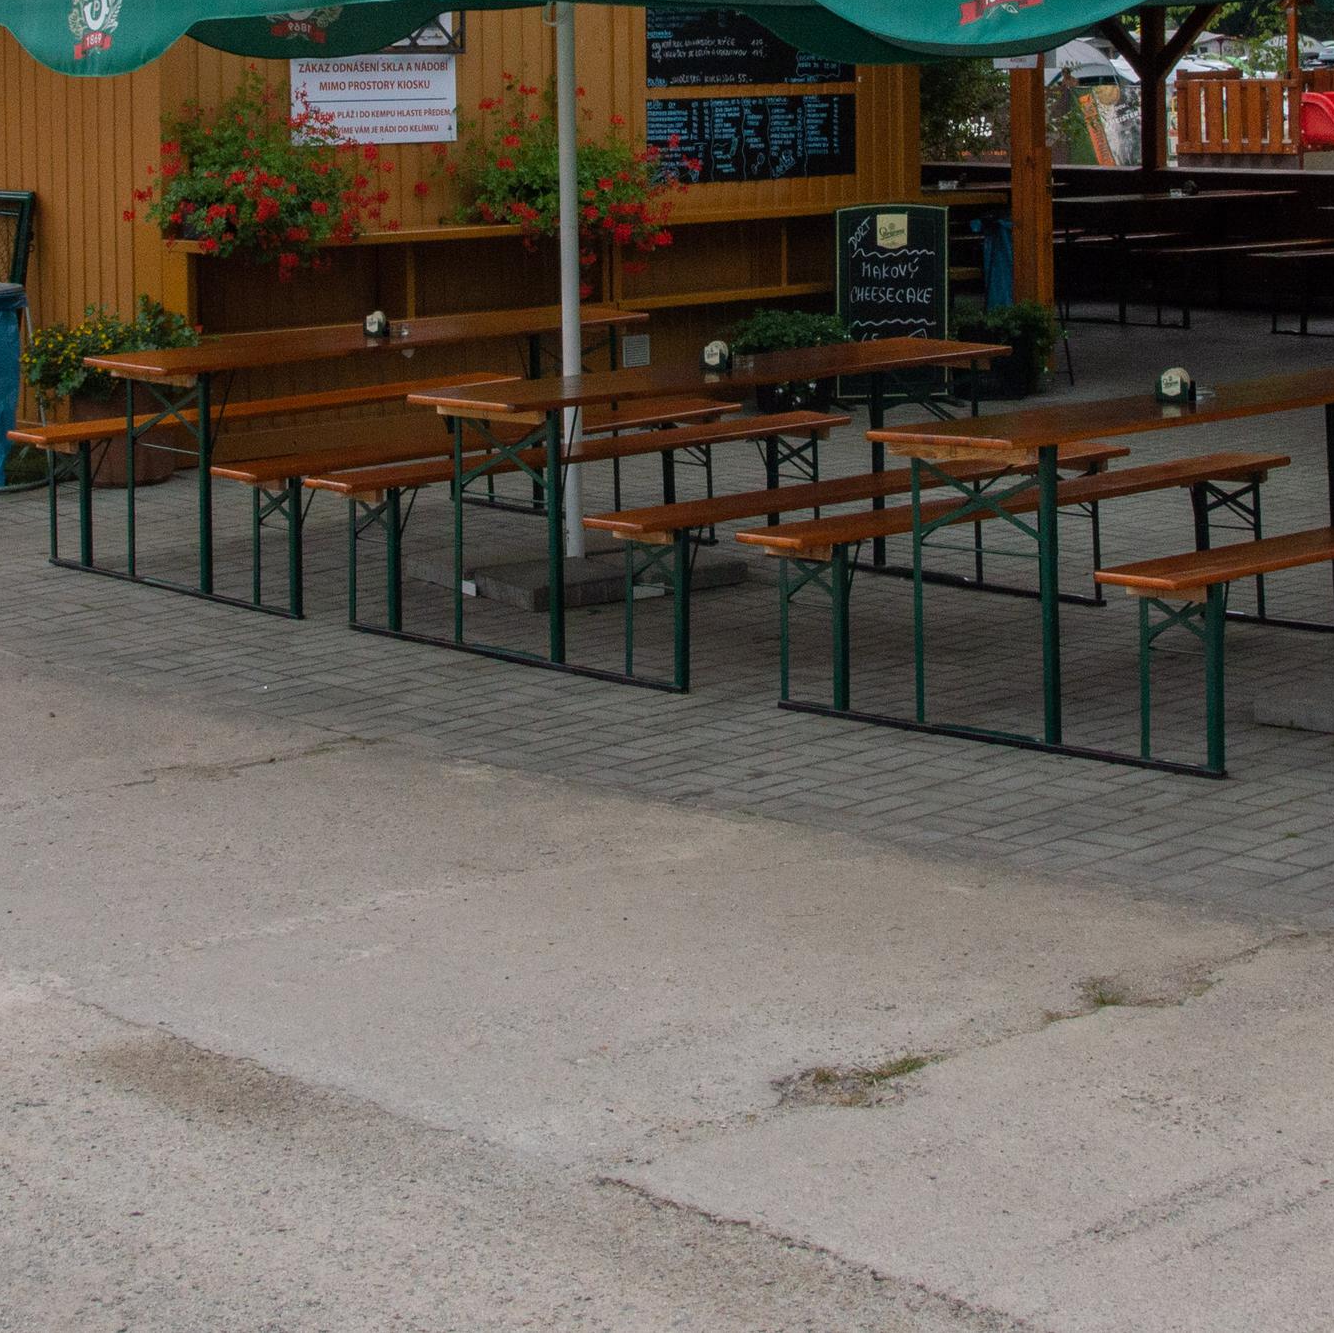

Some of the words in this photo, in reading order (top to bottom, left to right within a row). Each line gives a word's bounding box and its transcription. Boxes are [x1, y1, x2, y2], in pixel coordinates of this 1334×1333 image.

[86, 33, 102, 46] 1869
[298, 61, 330, 73] ZÁKAZ
[333, 60, 379, 72] ODNÁŠENÍ
[382, 62, 404, 72] SKLA
[406, 62, 412, 71] A
[414, 60, 449, 71] NÁDOBÍ
[319, 81, 345, 91] MIMO
[348, 80, 394, 91] PROSTORY
[397, 79, 431, 89] KIOSKU
[359, 110, 370, 118] DO
[371, 109, 395, 118] KEMPU
[397, 109, 423, 117] HLASTE
[355, 124, 370, 134] VÁM
[380, 124, 396, 134] RÁDI
[398, 125, 408, 133] DO
[409, 124, 439, 133] KELÍMKU
[861, 257, 919, 279] MAKOVÝ
[851, 286, 934, 304] CHEESECAKE
